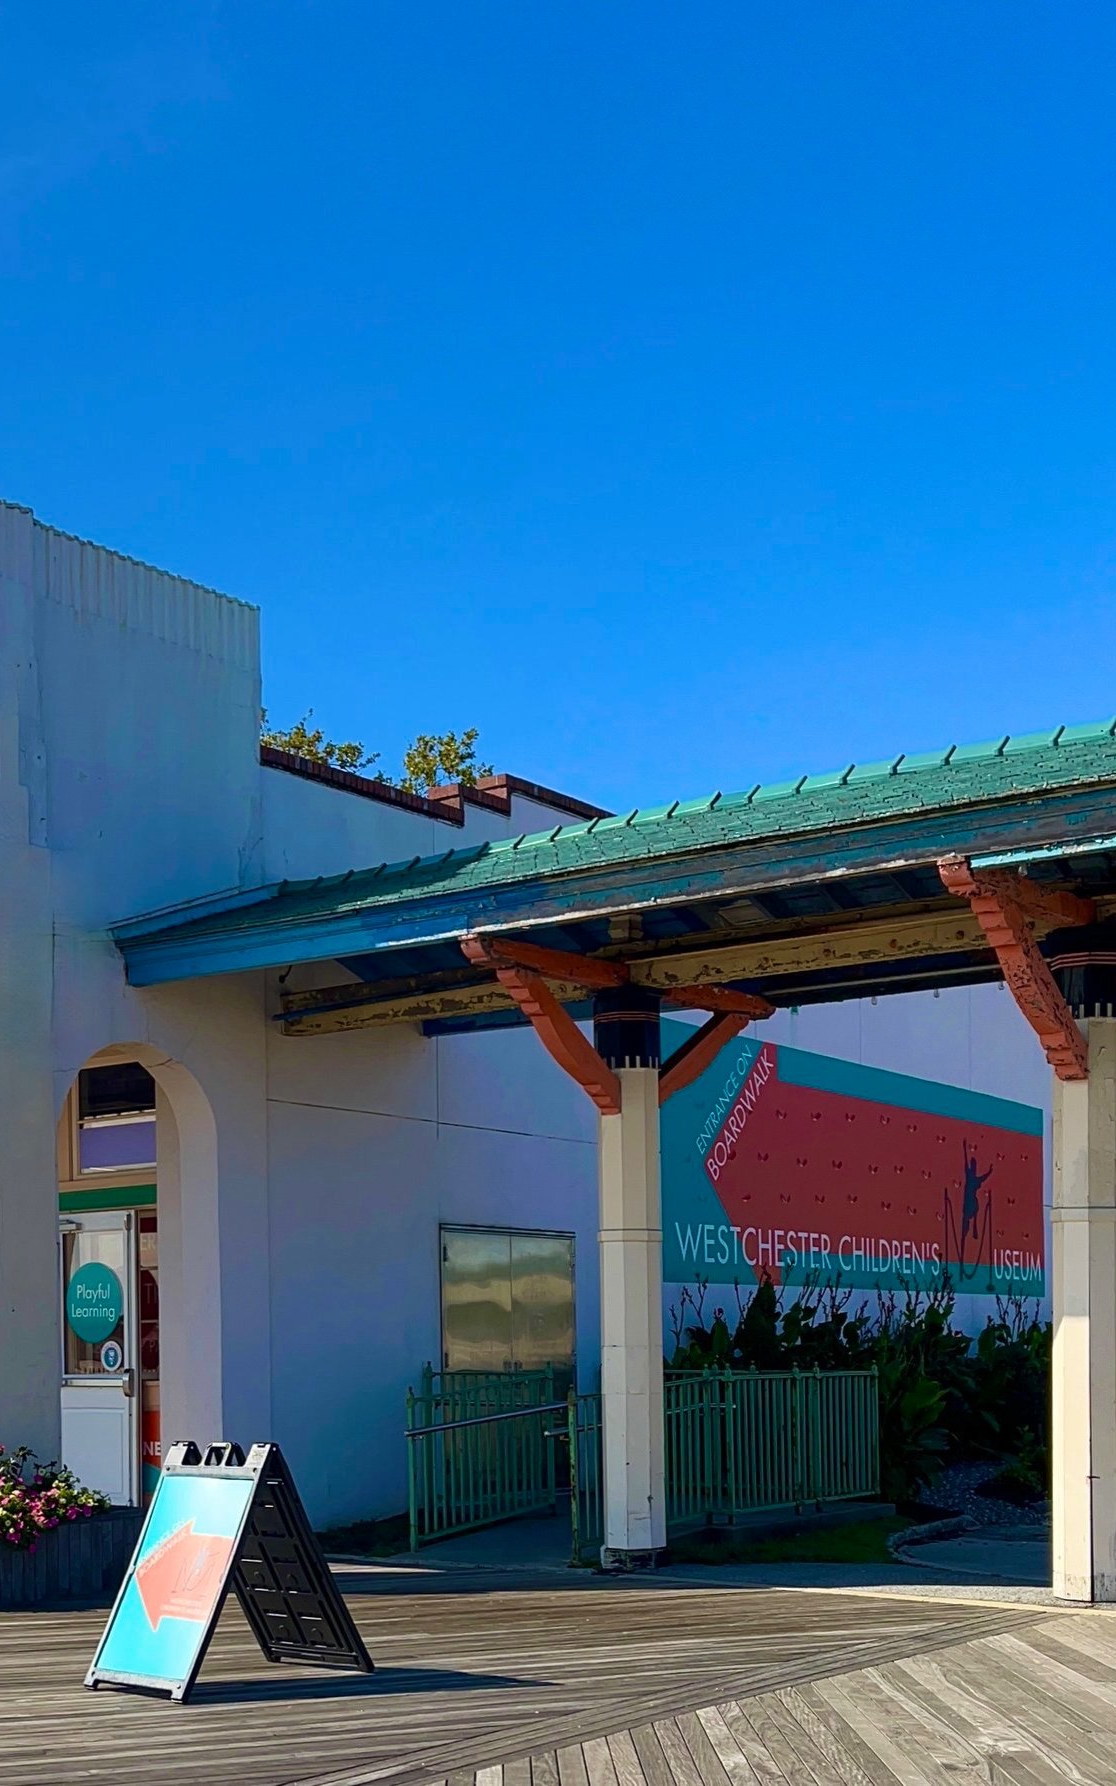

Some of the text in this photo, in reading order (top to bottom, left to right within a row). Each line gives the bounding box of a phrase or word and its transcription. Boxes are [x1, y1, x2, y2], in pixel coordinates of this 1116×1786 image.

[696, 1044, 753, 1154] ENTRANCE ON
[706, 1048, 774, 1181] BOARDWALK
[675, 1222, 832, 1270] WESTCHESTER
[838, 1235, 940, 1275] CHILDREN'S
[71, 1304, 116, 1322] Learning
[76, 1283, 111, 1301] Playful
